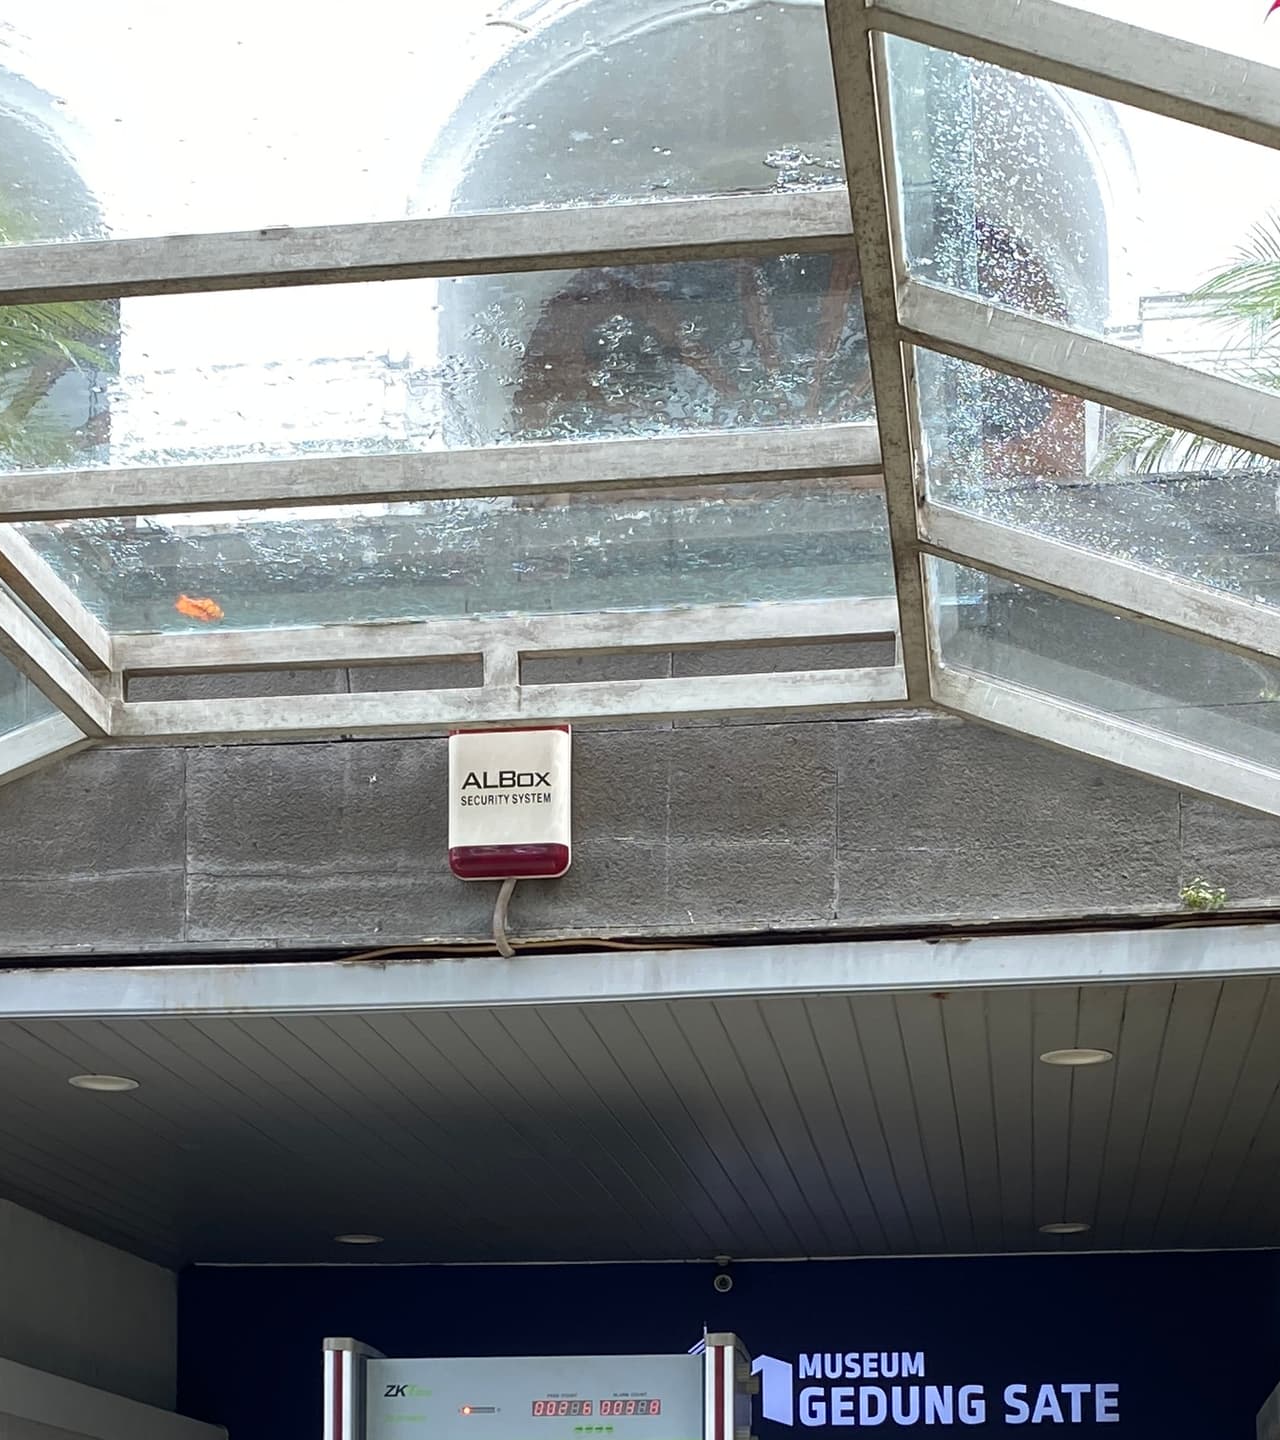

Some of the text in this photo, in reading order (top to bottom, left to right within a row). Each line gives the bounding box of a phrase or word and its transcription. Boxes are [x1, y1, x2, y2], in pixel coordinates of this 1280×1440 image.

[461, 793, 552, 807] SECURITY SYSTEM
[798, 1351, 925, 1379] MUSEUM
[798, 1383, 1120, 1427] GEDUNG SATE
